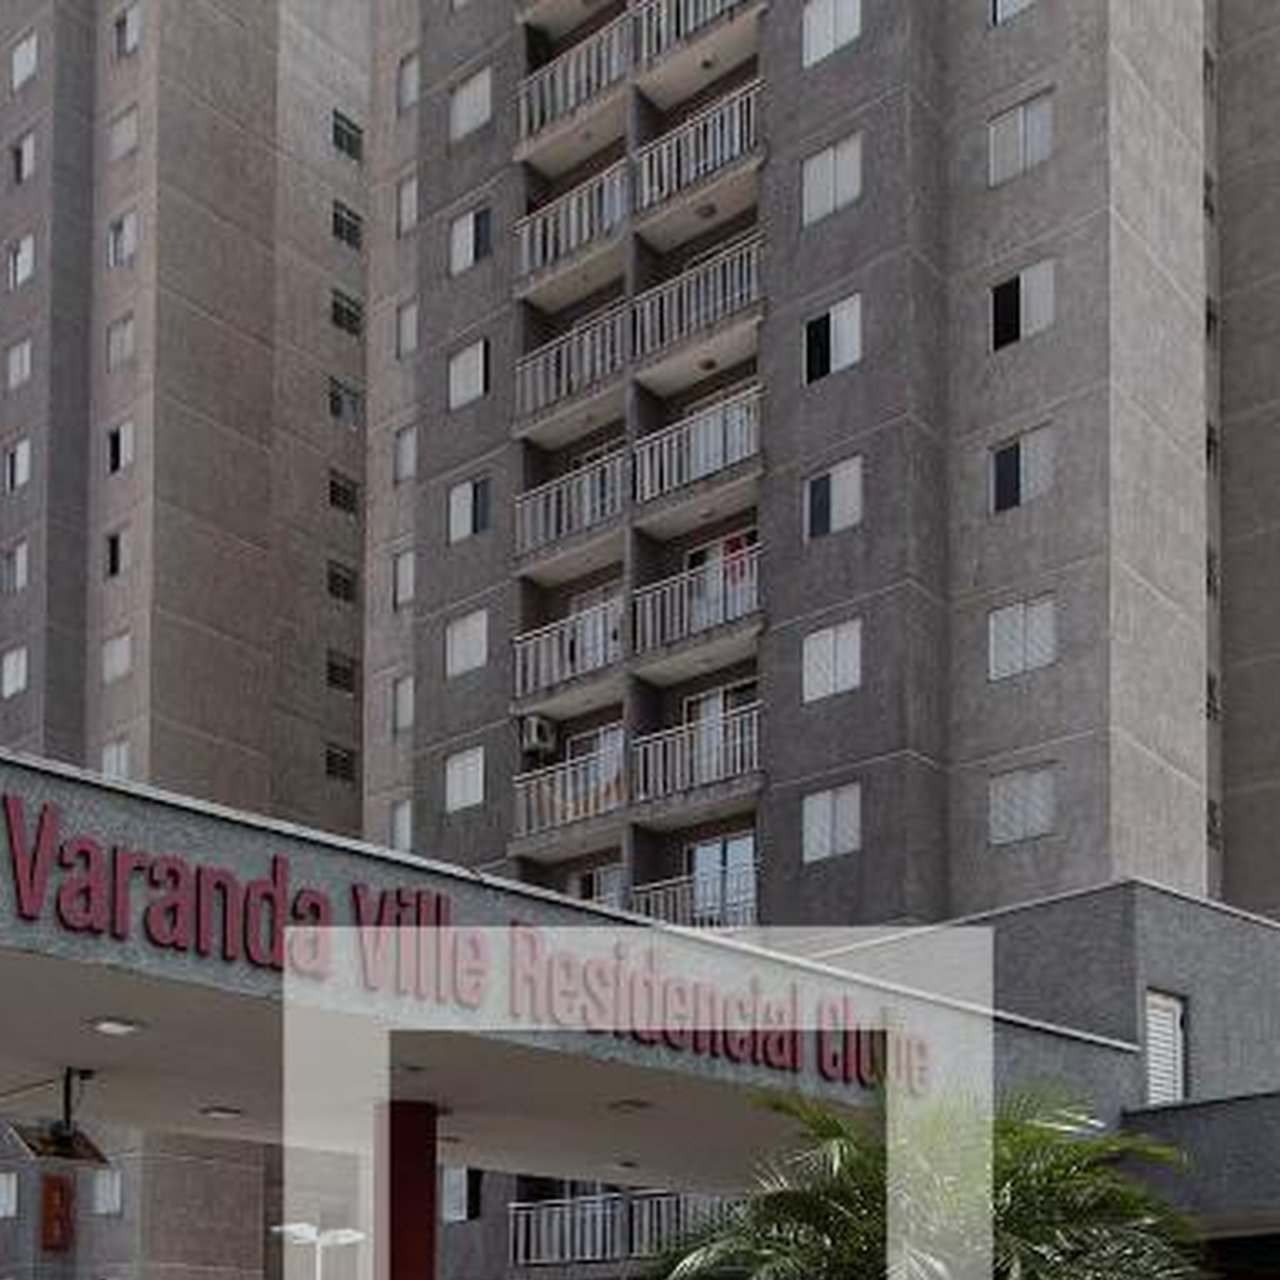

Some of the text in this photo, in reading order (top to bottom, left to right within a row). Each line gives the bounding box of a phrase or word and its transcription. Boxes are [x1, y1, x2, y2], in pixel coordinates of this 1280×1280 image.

[3, 795, 334, 980] Varanda
[351, 883, 488, 1012] Ville
[510, 920, 800, 1073] Residencial
